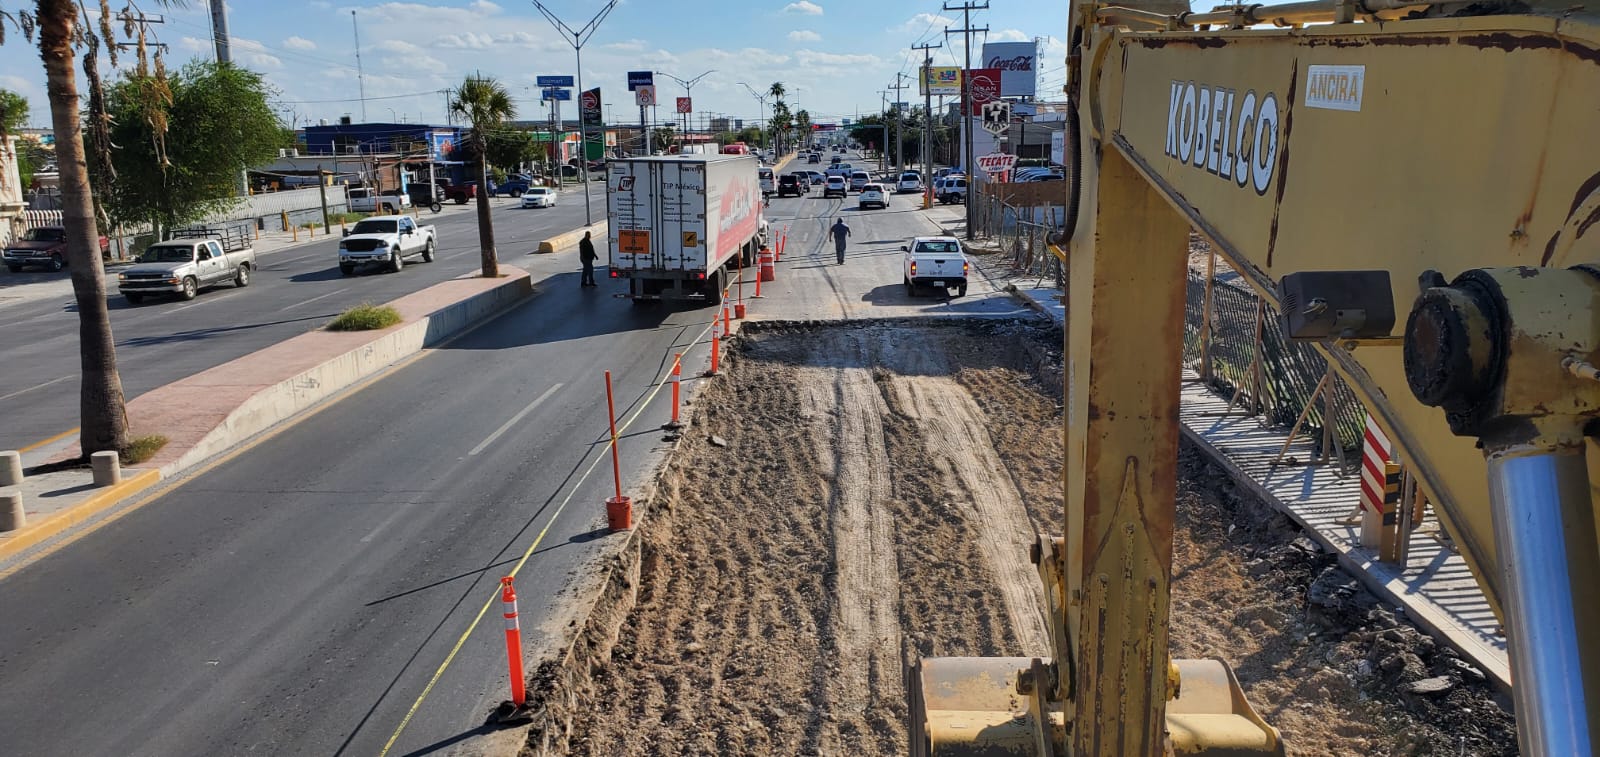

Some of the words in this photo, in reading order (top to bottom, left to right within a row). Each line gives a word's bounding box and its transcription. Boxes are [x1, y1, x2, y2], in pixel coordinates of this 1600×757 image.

[988, 56, 1034, 71] Coca-Cola
[1311, 73, 1357, 102] ANCIRA
[1165, 79, 1279, 196] KOBELCO
[980, 156, 1013, 167] TECATE
[622, 179, 632, 188] TIP
[662, 182, 674, 190] TIP
